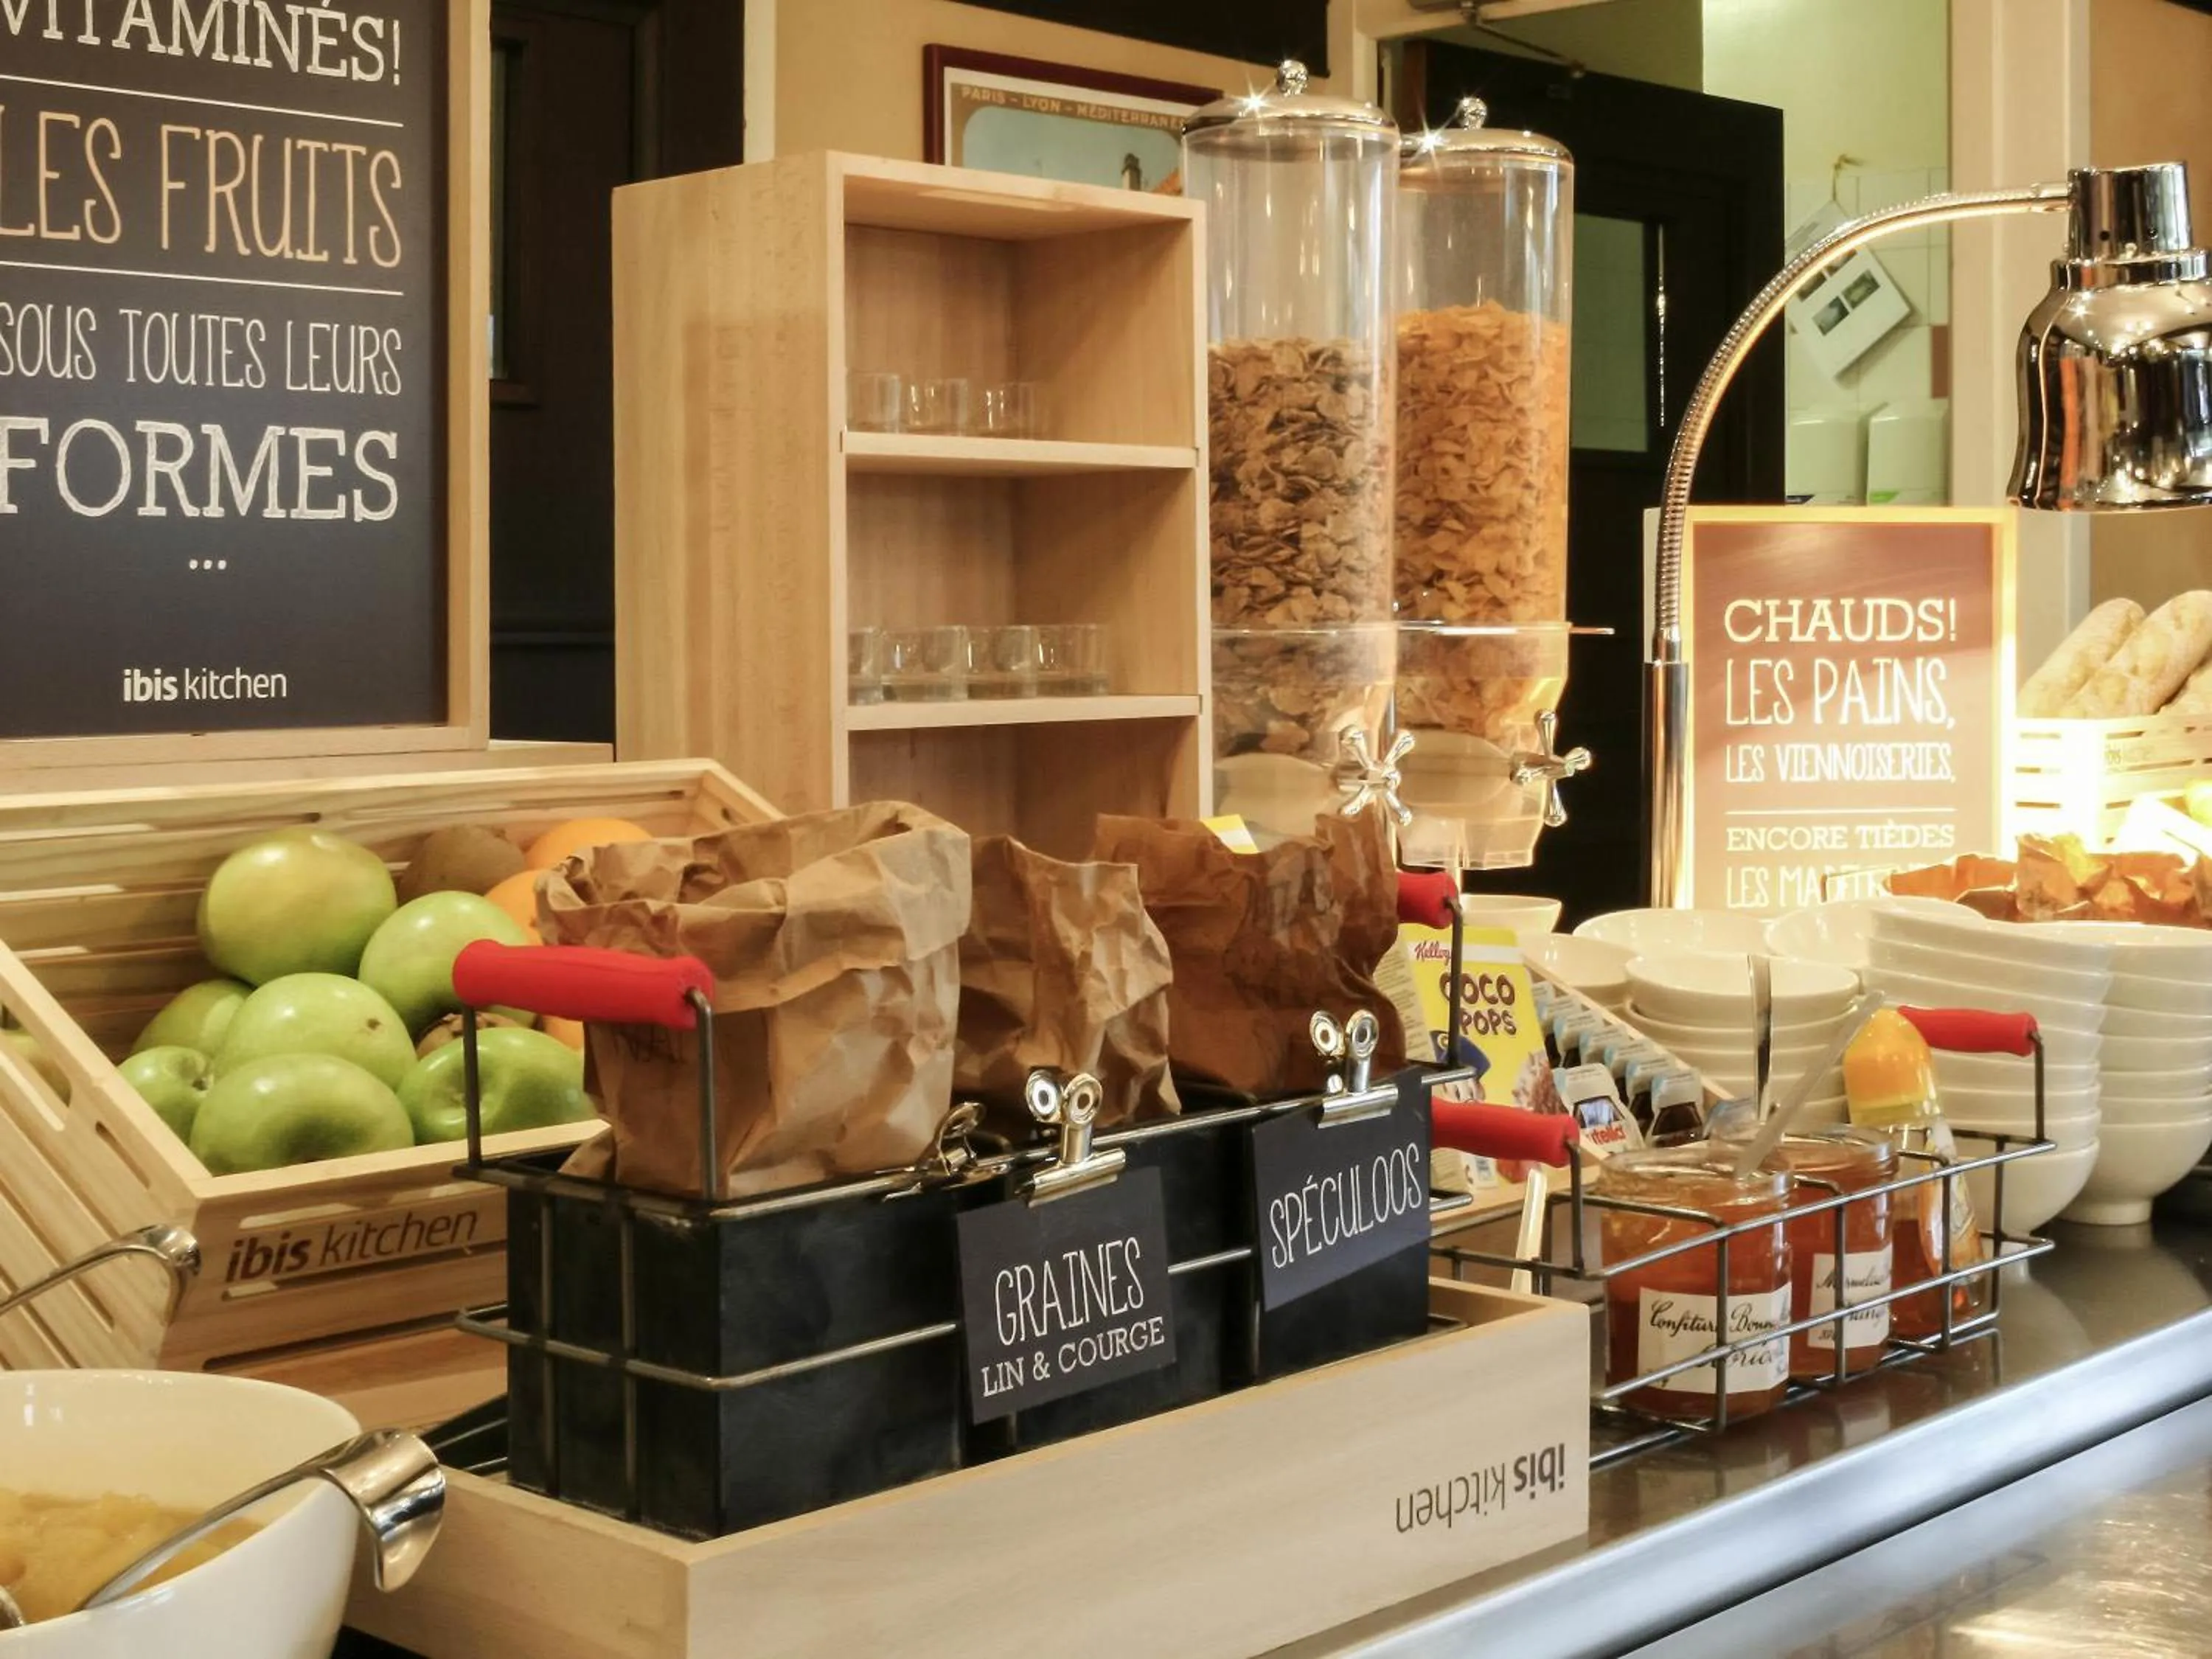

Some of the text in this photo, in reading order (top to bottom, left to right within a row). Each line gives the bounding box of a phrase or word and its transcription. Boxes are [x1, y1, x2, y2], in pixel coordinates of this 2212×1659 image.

[961, 86, 1006, 105] PARIS
[1022, 94, 1061, 112] LYON
[161, 125, 402, 268] FRUITS
[0, 302, 402, 395] SOUS TOUTES LEURS
[0, 416, 398, 521] FORMES
[1725, 598, 1958, 642] CHAUDS!
[123, 667, 287, 701] ibis kitchen
[1726, 657, 1955, 729] LES PAINS,
[1726, 744, 1764, 782] LES
[1727, 819, 1955, 852] ENCORE TIÈDES
[1727, 866, 1769, 908] LES
[1459, 1007, 1517, 1035] POPS
[1270, 1141, 1422, 1269] SPÉCULOOS
[226, 1210, 478, 1283] ibis kitchen
[995, 1237, 1144, 1346] GRAINES
[981, 1316, 1165, 1397] LIN & COURGE
[1396, 1443, 1565, 1533] ibis kitchen
